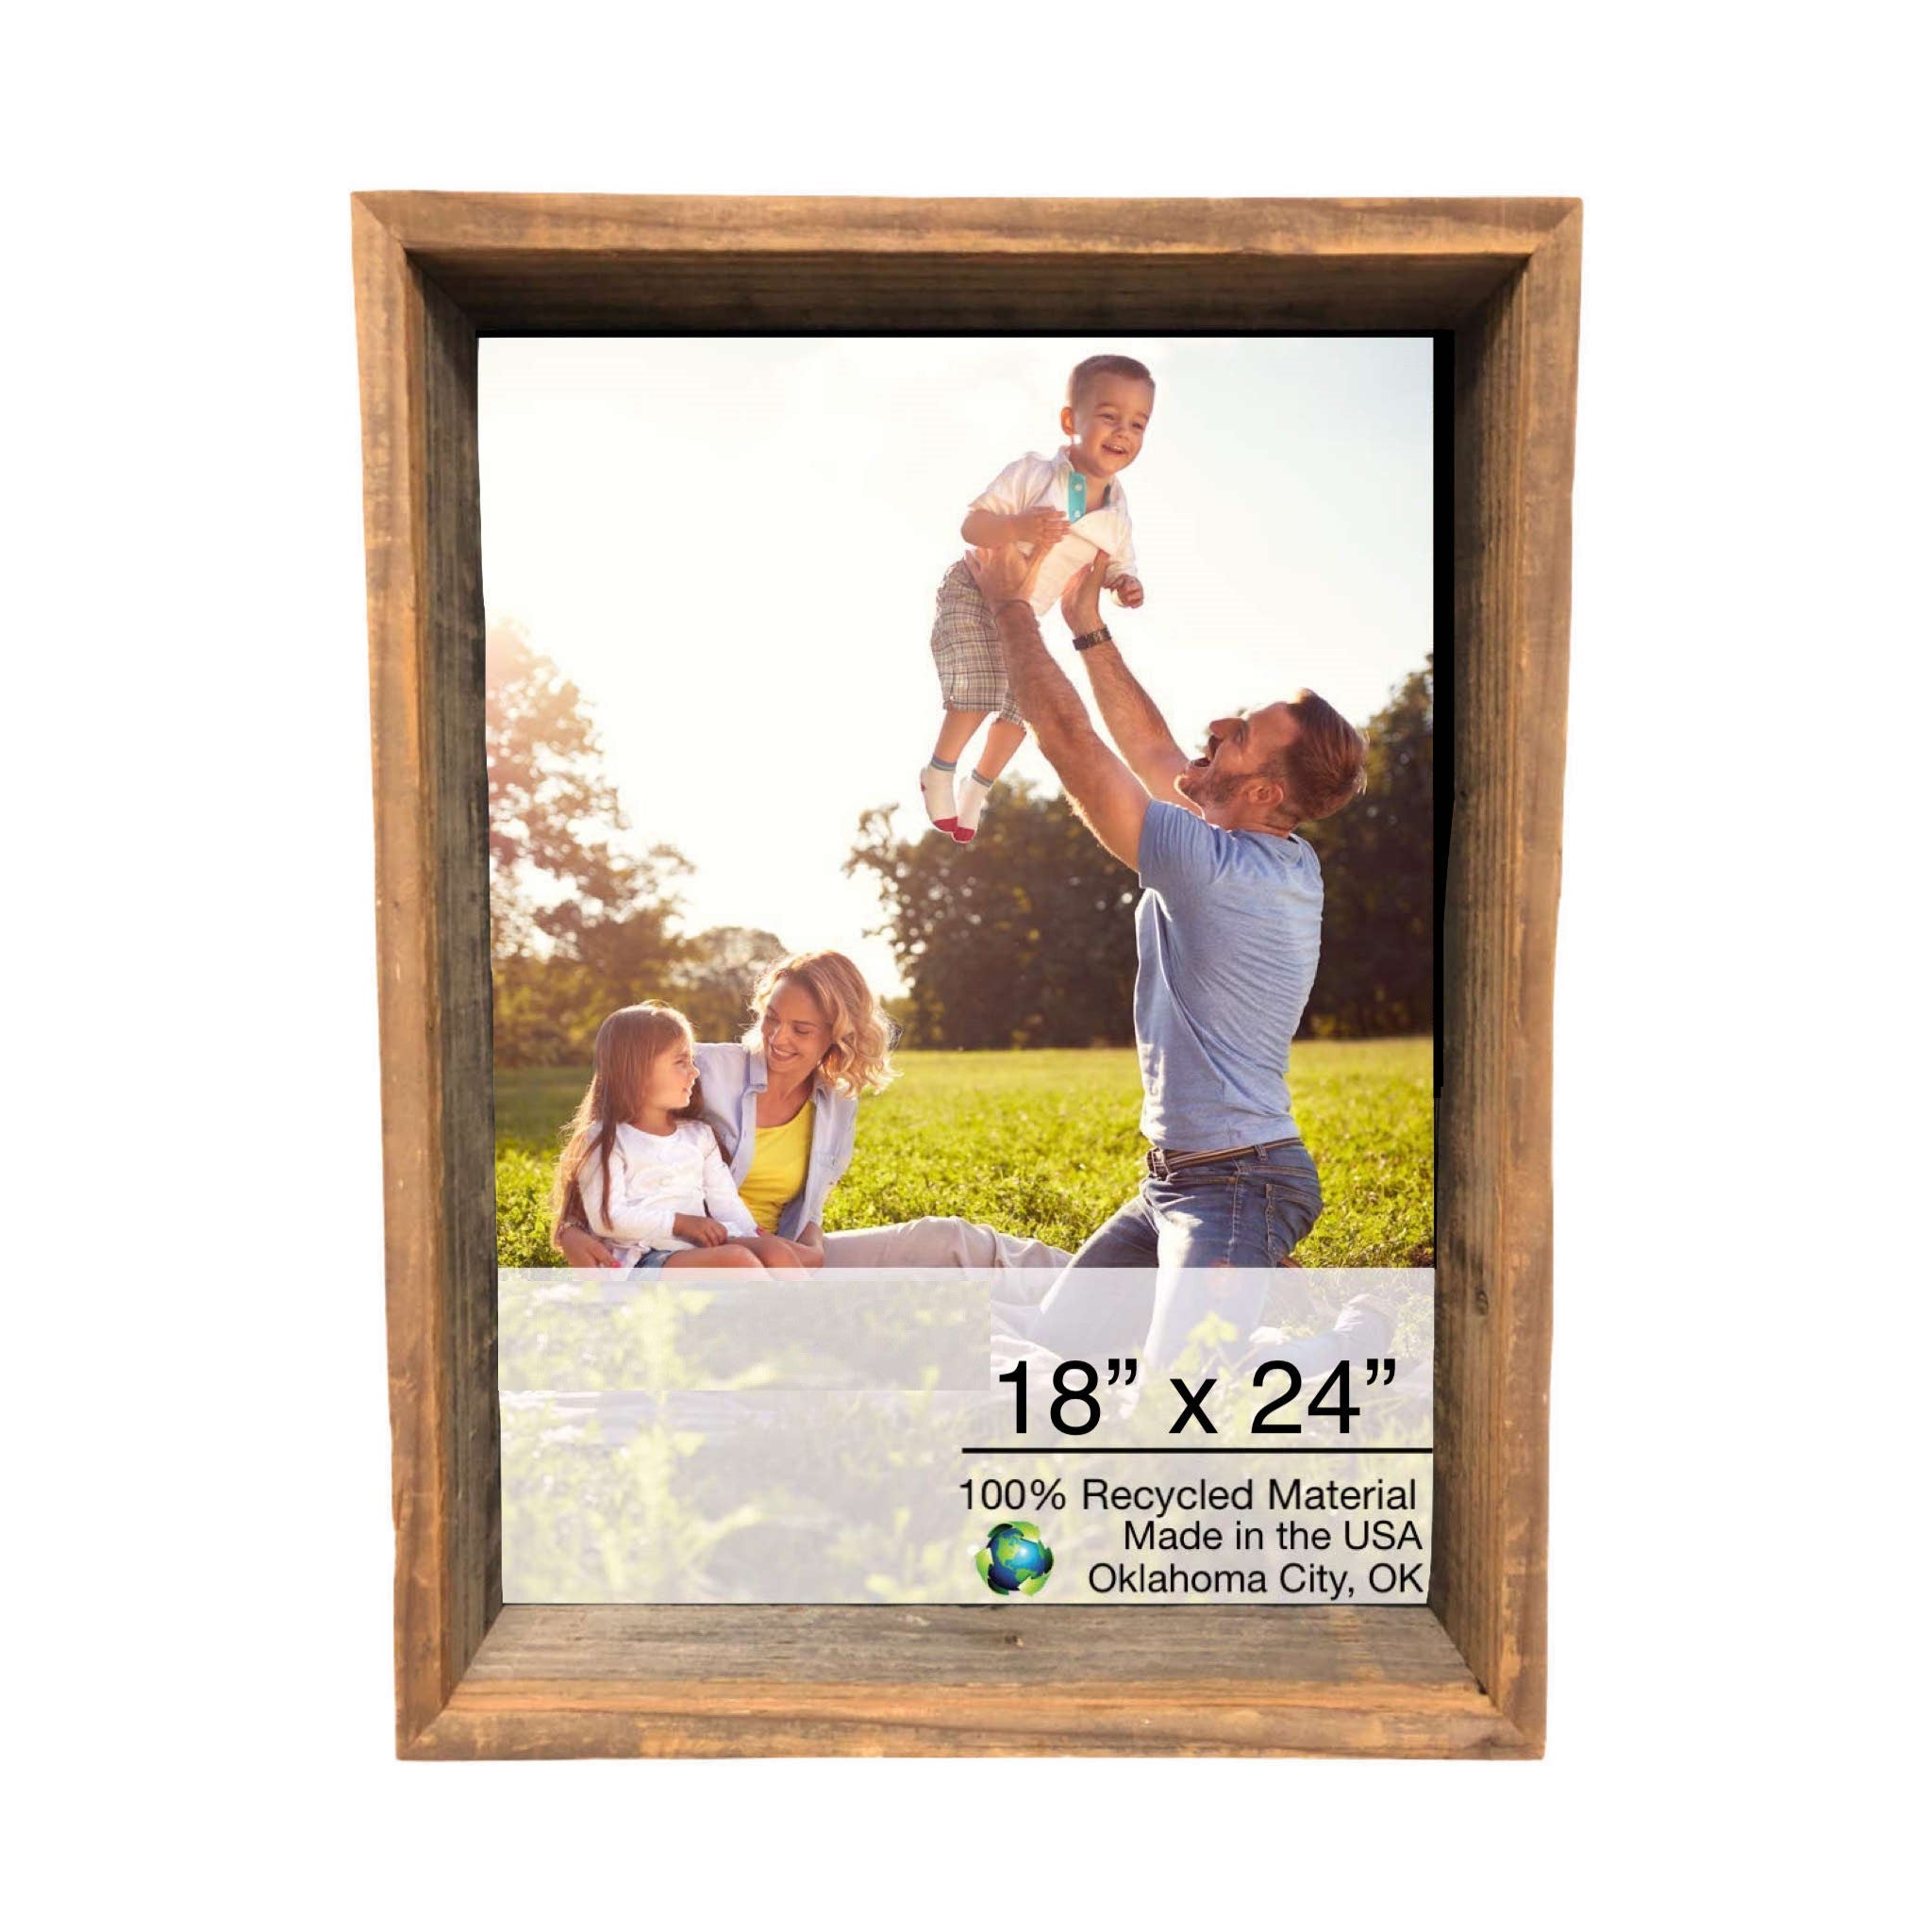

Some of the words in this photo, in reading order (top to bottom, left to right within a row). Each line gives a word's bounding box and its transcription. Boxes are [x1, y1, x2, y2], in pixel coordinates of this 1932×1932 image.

[998, 1357, 1138, 1436] 18”
[1168, 1378, 1218, 1434] x
[1251, 1357, 1396, 1434] 24”
[959, 1478, 1066, 1511] 100%
[1083, 1478, 1253, 1519] Recycled
[1269, 1478, 1416, 1511] Material
[1124, 1520, 1223, 1550] Made
[1236, 1520, 1263, 1550] in
[1275, 1520, 1332, 1550] the
[1344, 1520, 1424, 1550] USA
[1089, 1562, 1268, 1593] Oklahoma
[1279, 1562, 1355, 1601] City,
[1369, 1562, 1424, 1593] OK
